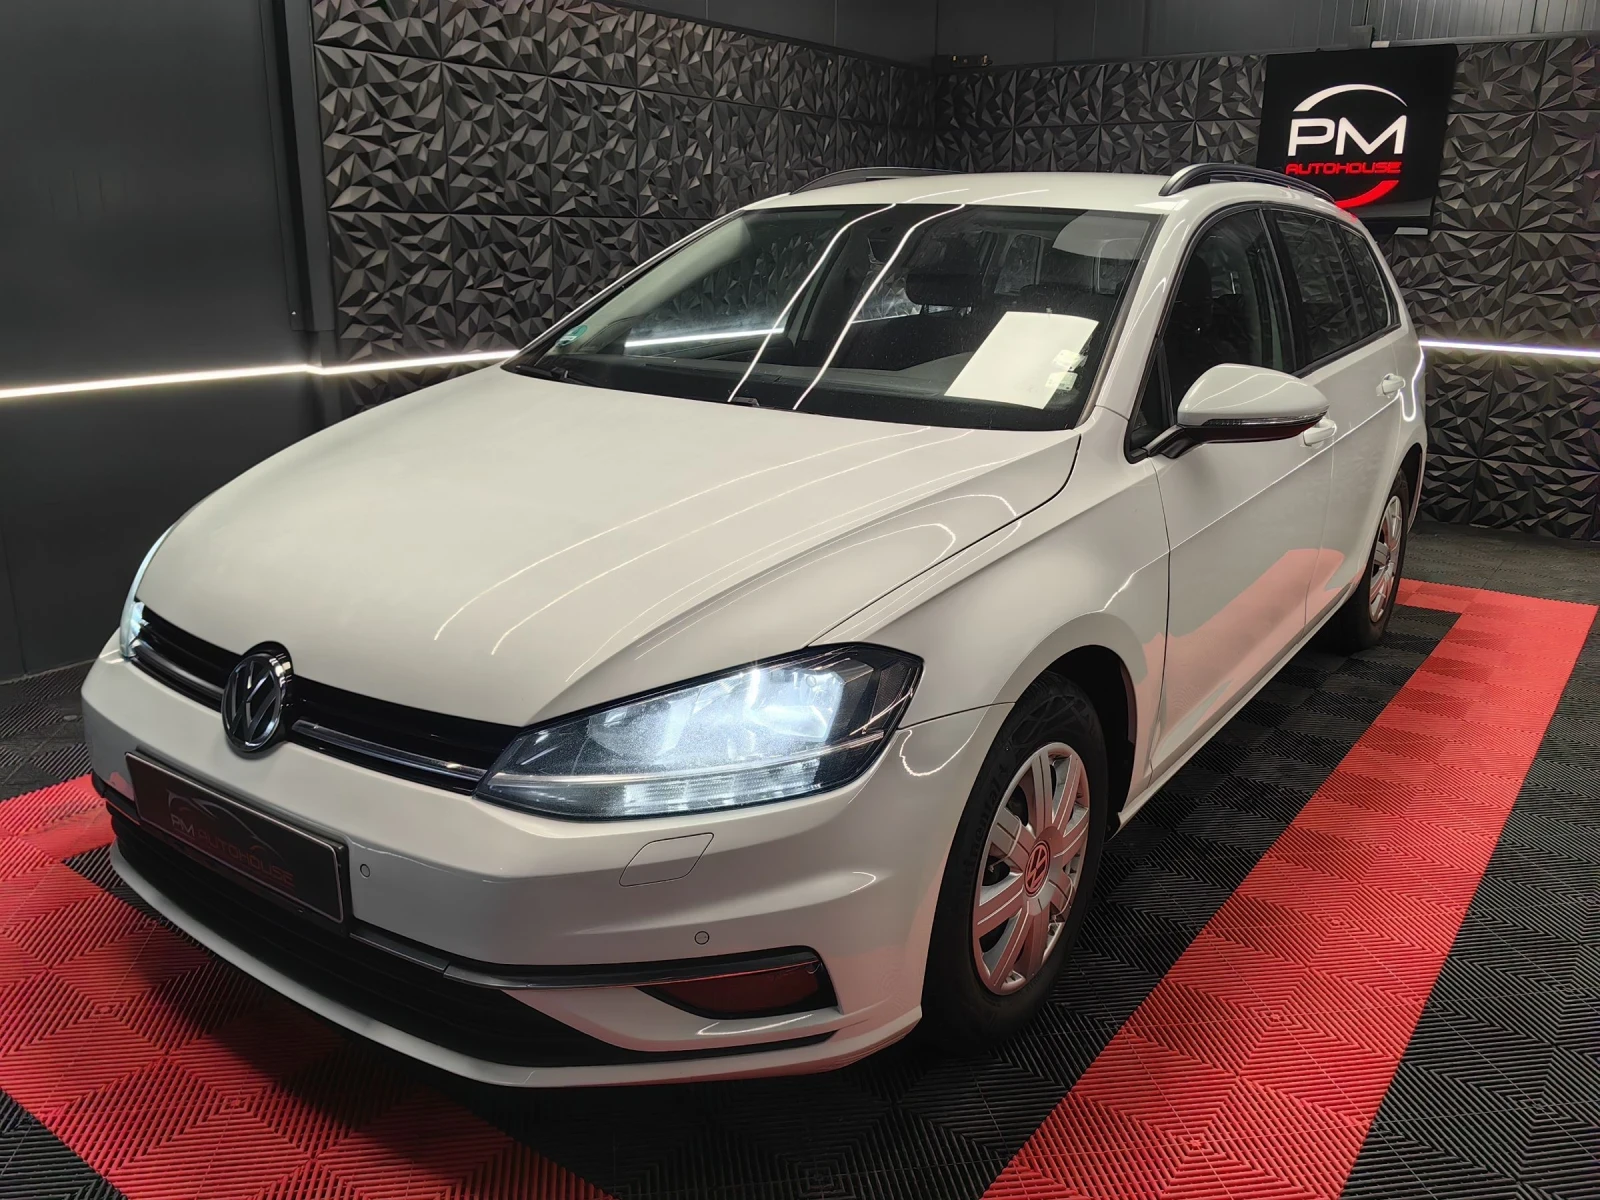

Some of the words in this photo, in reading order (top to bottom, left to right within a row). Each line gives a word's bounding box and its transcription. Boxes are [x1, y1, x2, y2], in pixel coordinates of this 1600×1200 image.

[1287, 115, 1408, 157] PM
[1285, 161, 1403, 175] AUTOHOUSE
[170, 813, 196, 837] PM
[198, 830, 295, 884] AUTOHOUSE
